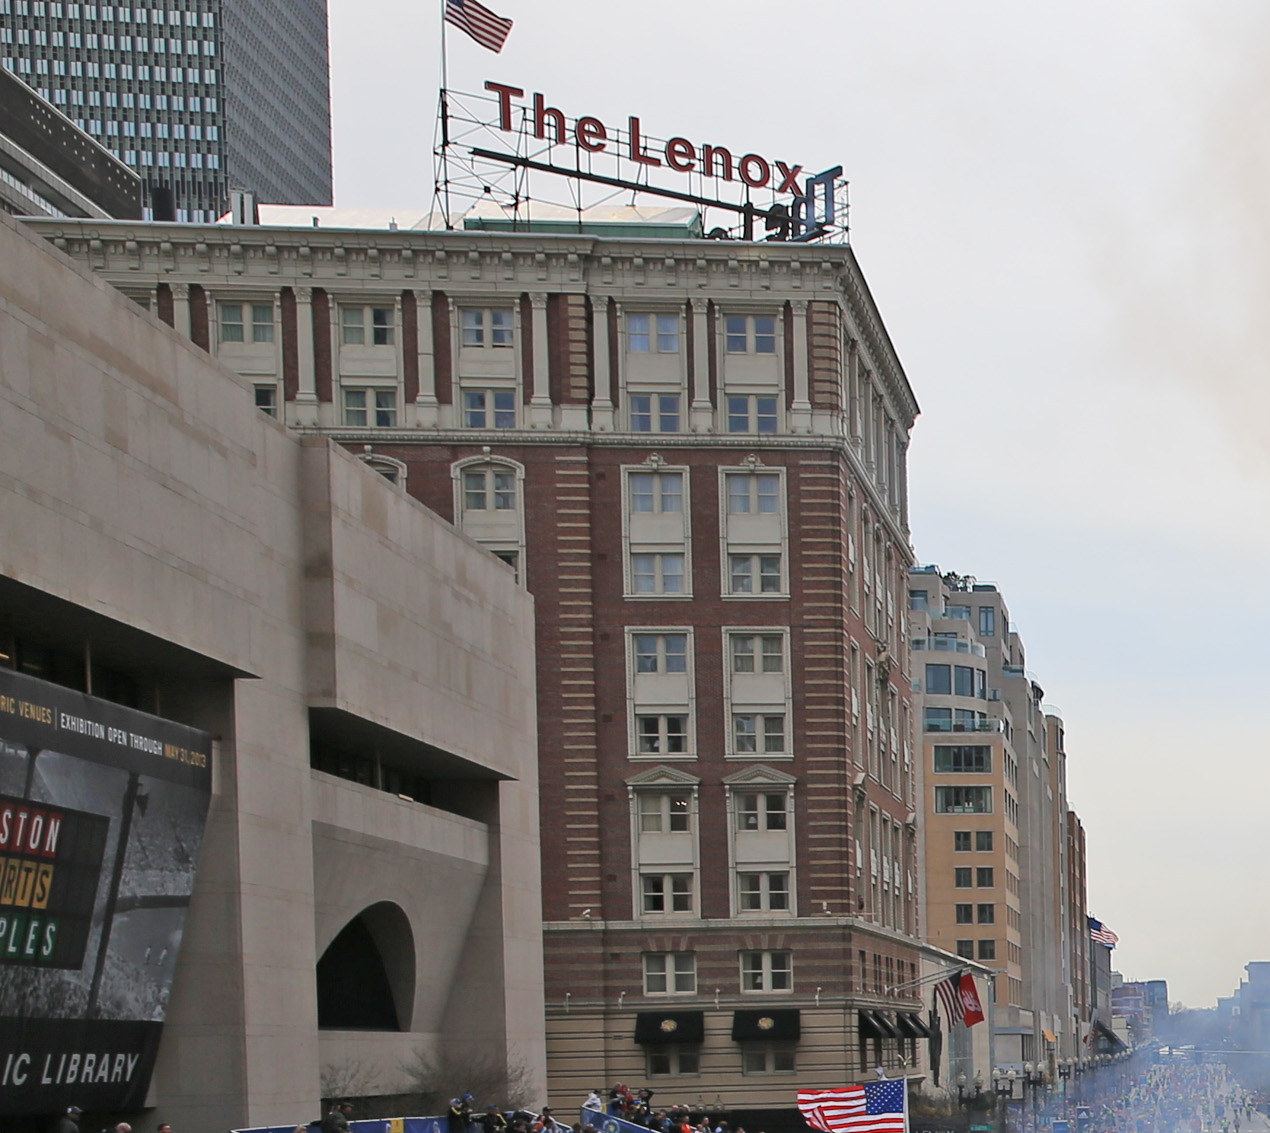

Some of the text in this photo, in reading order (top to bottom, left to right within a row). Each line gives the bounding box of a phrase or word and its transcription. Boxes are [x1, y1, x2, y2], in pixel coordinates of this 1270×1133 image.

[485, 80, 803, 197] The Lenox
[18, 700, 52, 724] VENUES
[60, 712, 105, 740] EXHIBITION
[107, 727, 128, 747] OPEN
[130, 732, 163, 756] THROUGH
[164, 743, 180, 760] MAY
[0, 860, 50, 904] RTS
[2, 1052, 140, 1086] IC LIBRARY
